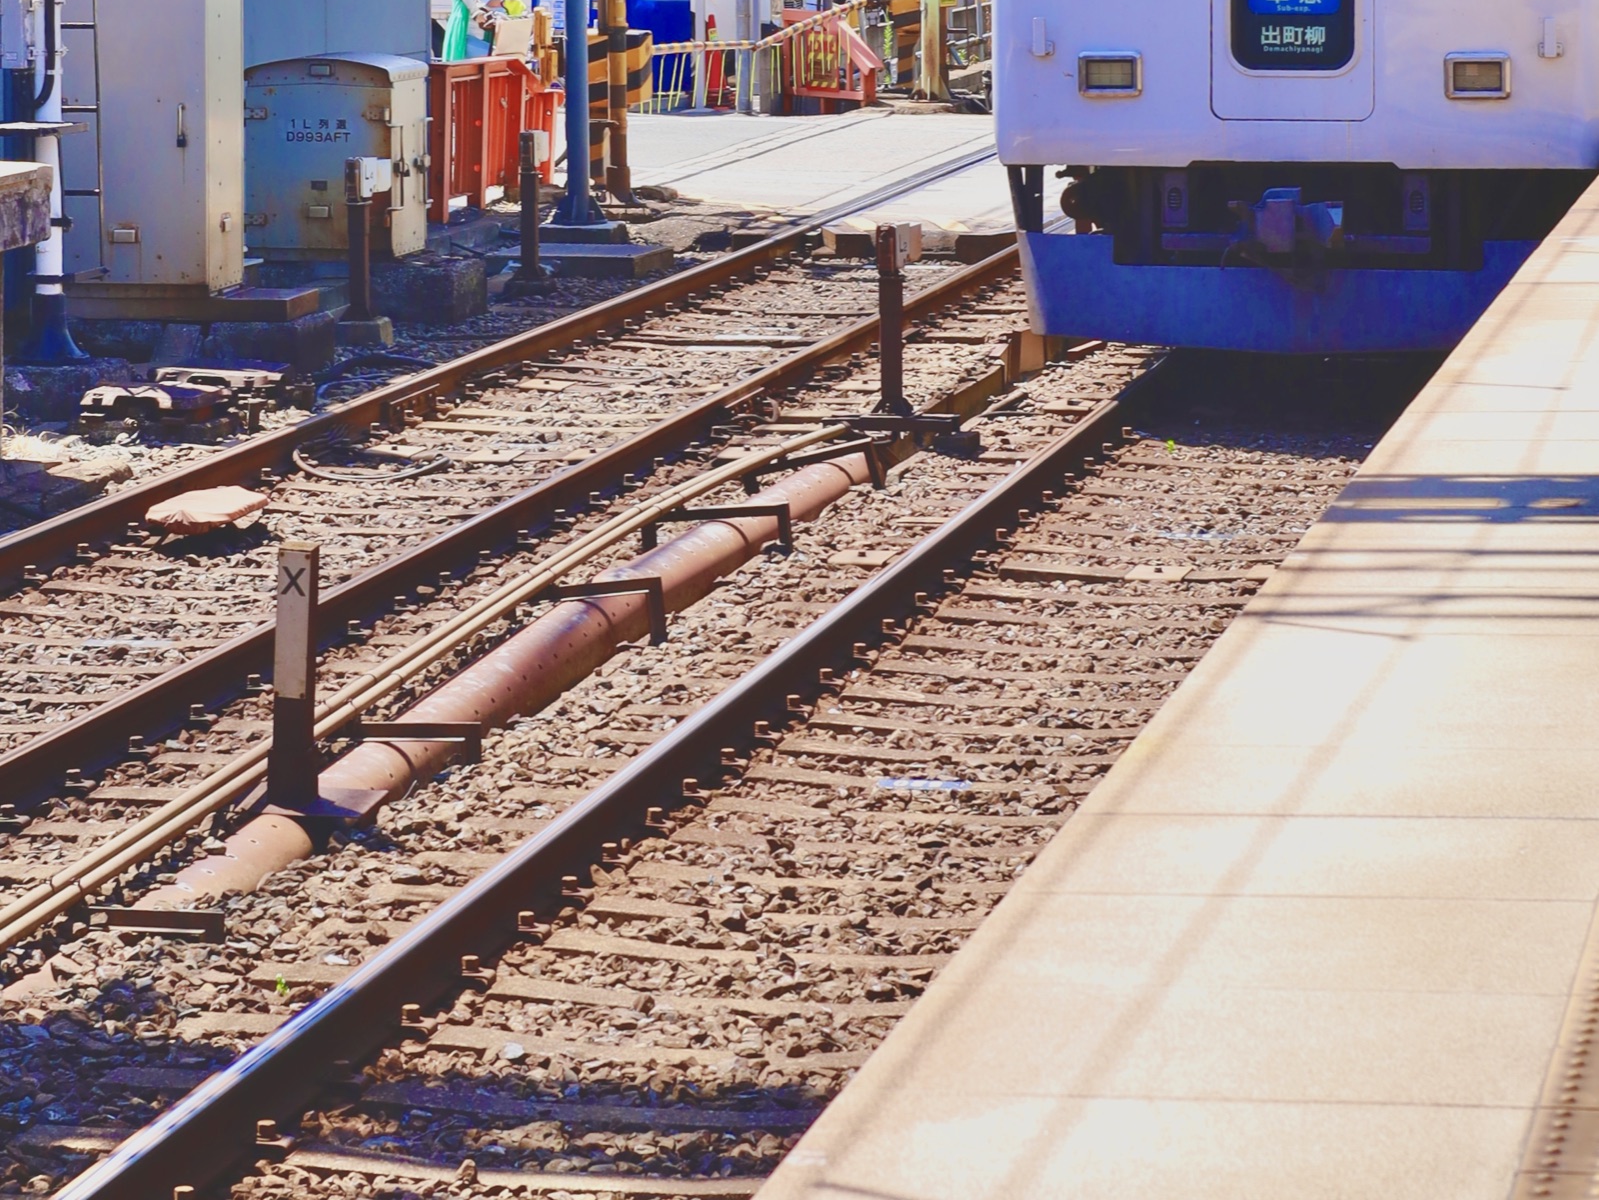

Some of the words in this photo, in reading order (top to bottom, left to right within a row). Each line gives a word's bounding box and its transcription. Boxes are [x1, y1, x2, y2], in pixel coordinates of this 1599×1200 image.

[1261, 25, 1326, 45] 出町柳
[1263, 45, 1323, 54] Demachiyanagi
[286, 131, 351, 143] D993AFT
[280, 566, 306, 597] X
